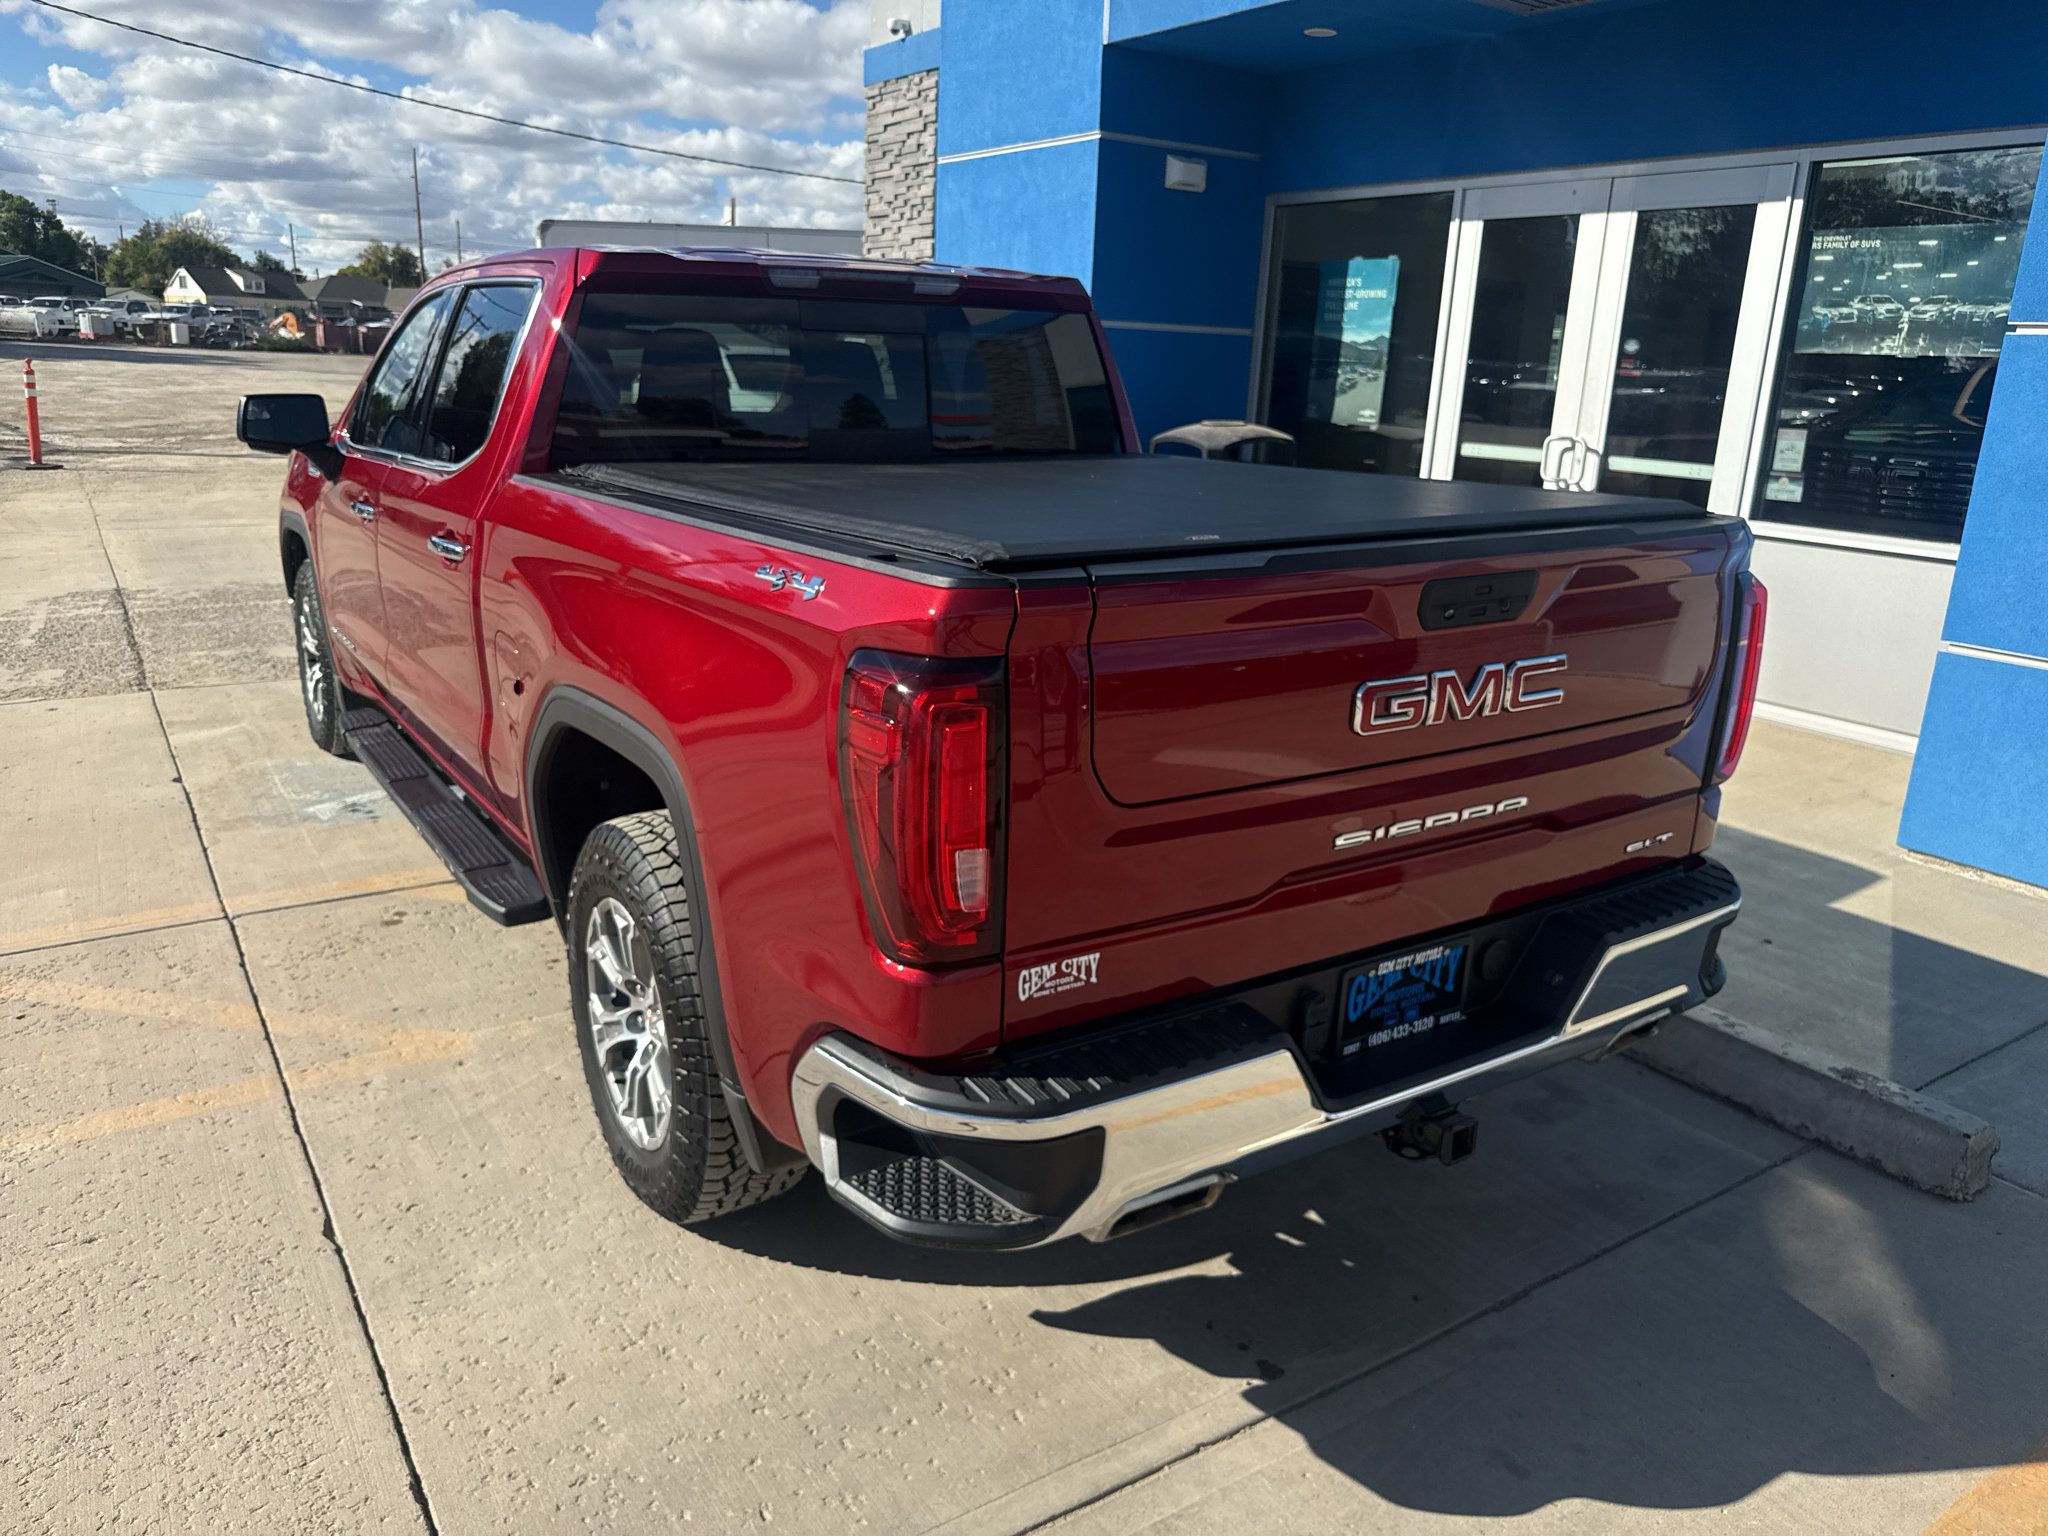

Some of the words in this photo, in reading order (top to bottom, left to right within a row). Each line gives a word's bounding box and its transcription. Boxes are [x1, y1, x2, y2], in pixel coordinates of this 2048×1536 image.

[1812, 241, 1822, 250] RS
[1823, 240, 1849, 249] FAMILY
[1850, 240, 1860, 248] OF
[1861, 239, 1881, 248] SUVS
[1353, 653, 1569, 737] GMC
[1333, 796, 1530, 851] SIERRA
[1623, 831, 1675, 854] SLT
[1018, 962, 1058, 1002] GEM
[1060, 951, 1101, 984] CITY
[1377, 960, 1396, 976] GEM
[1395, 954, 1415, 971] CITY
[1413, 946, 1444, 966] MOTORS
[1044, 975, 1075, 989] MOTORS
[1367, 1027, 1393, 1048] (406)
[1392, 1015, 1435, 1040] 433-3120
